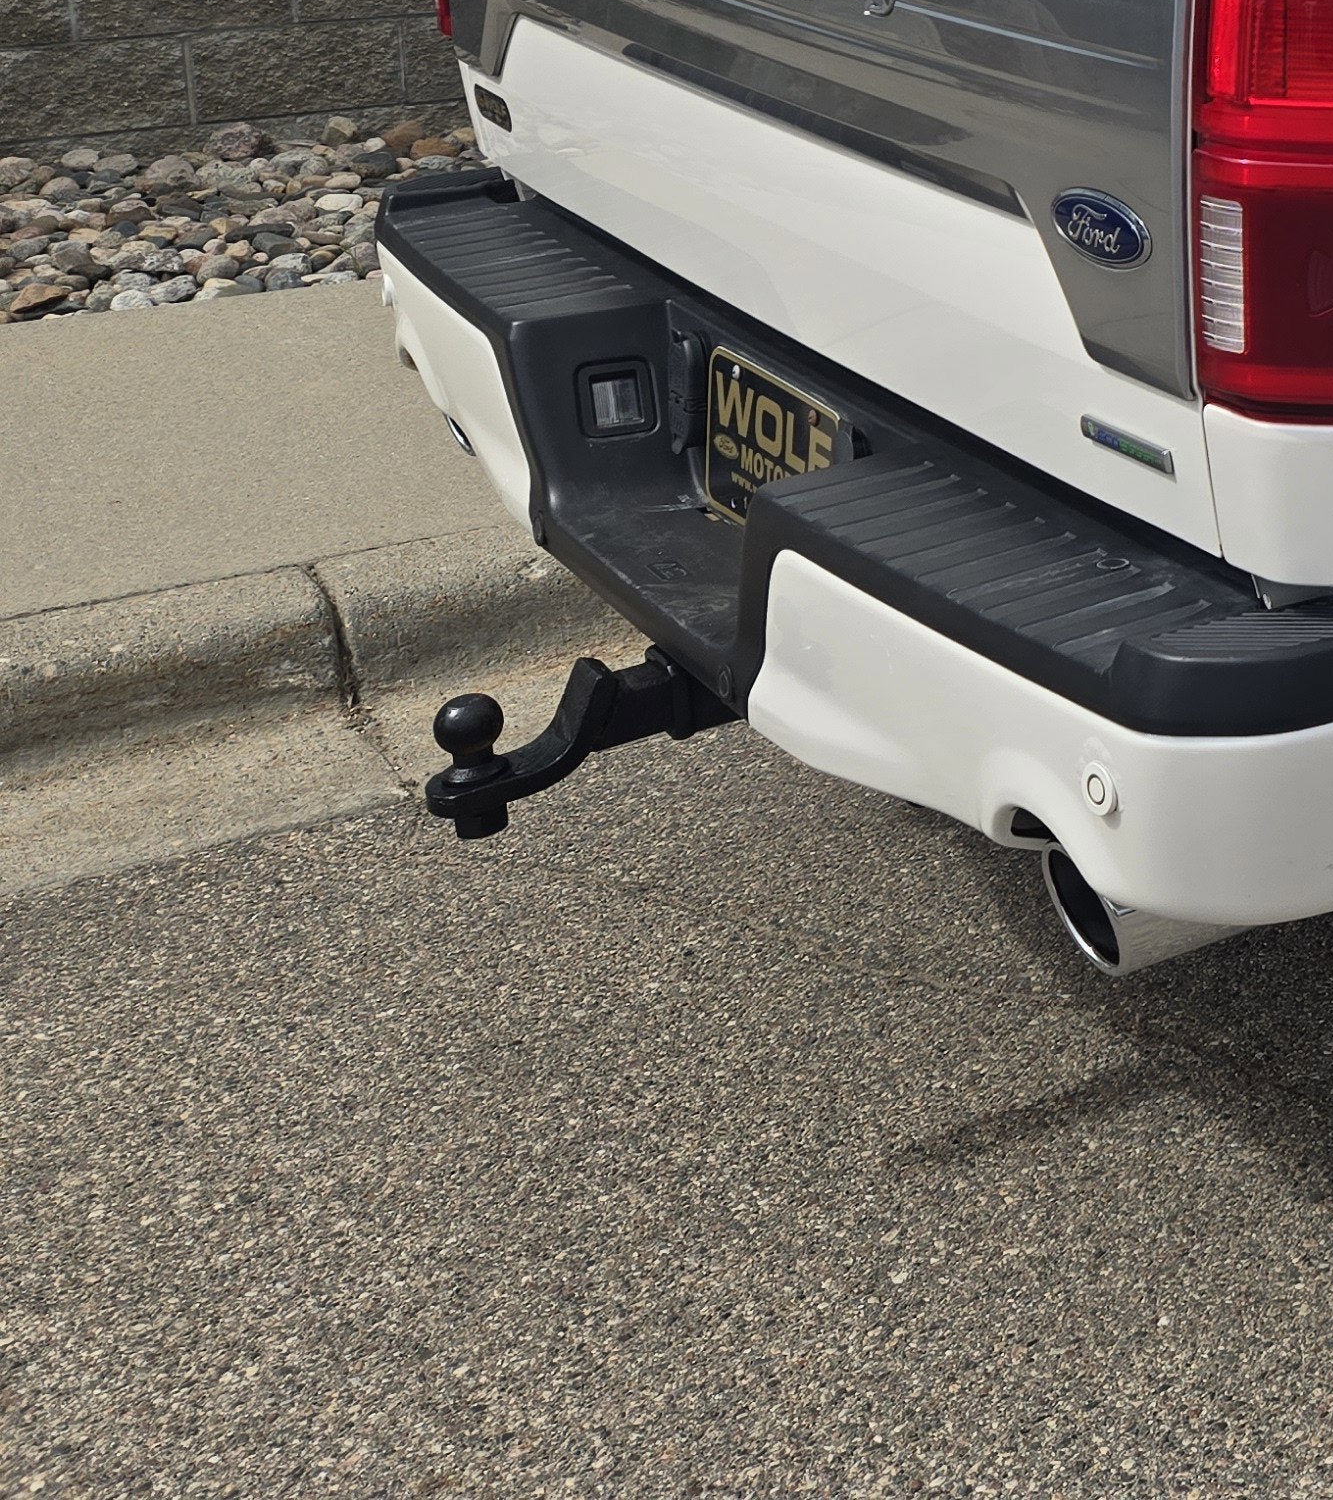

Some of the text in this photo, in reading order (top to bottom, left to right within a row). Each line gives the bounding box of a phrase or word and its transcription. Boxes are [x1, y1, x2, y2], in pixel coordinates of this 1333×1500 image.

[1067, 203, 1121, 254] Ford
[715, 370, 833, 473] WOLF
[741, 443, 791, 484] MOTO
